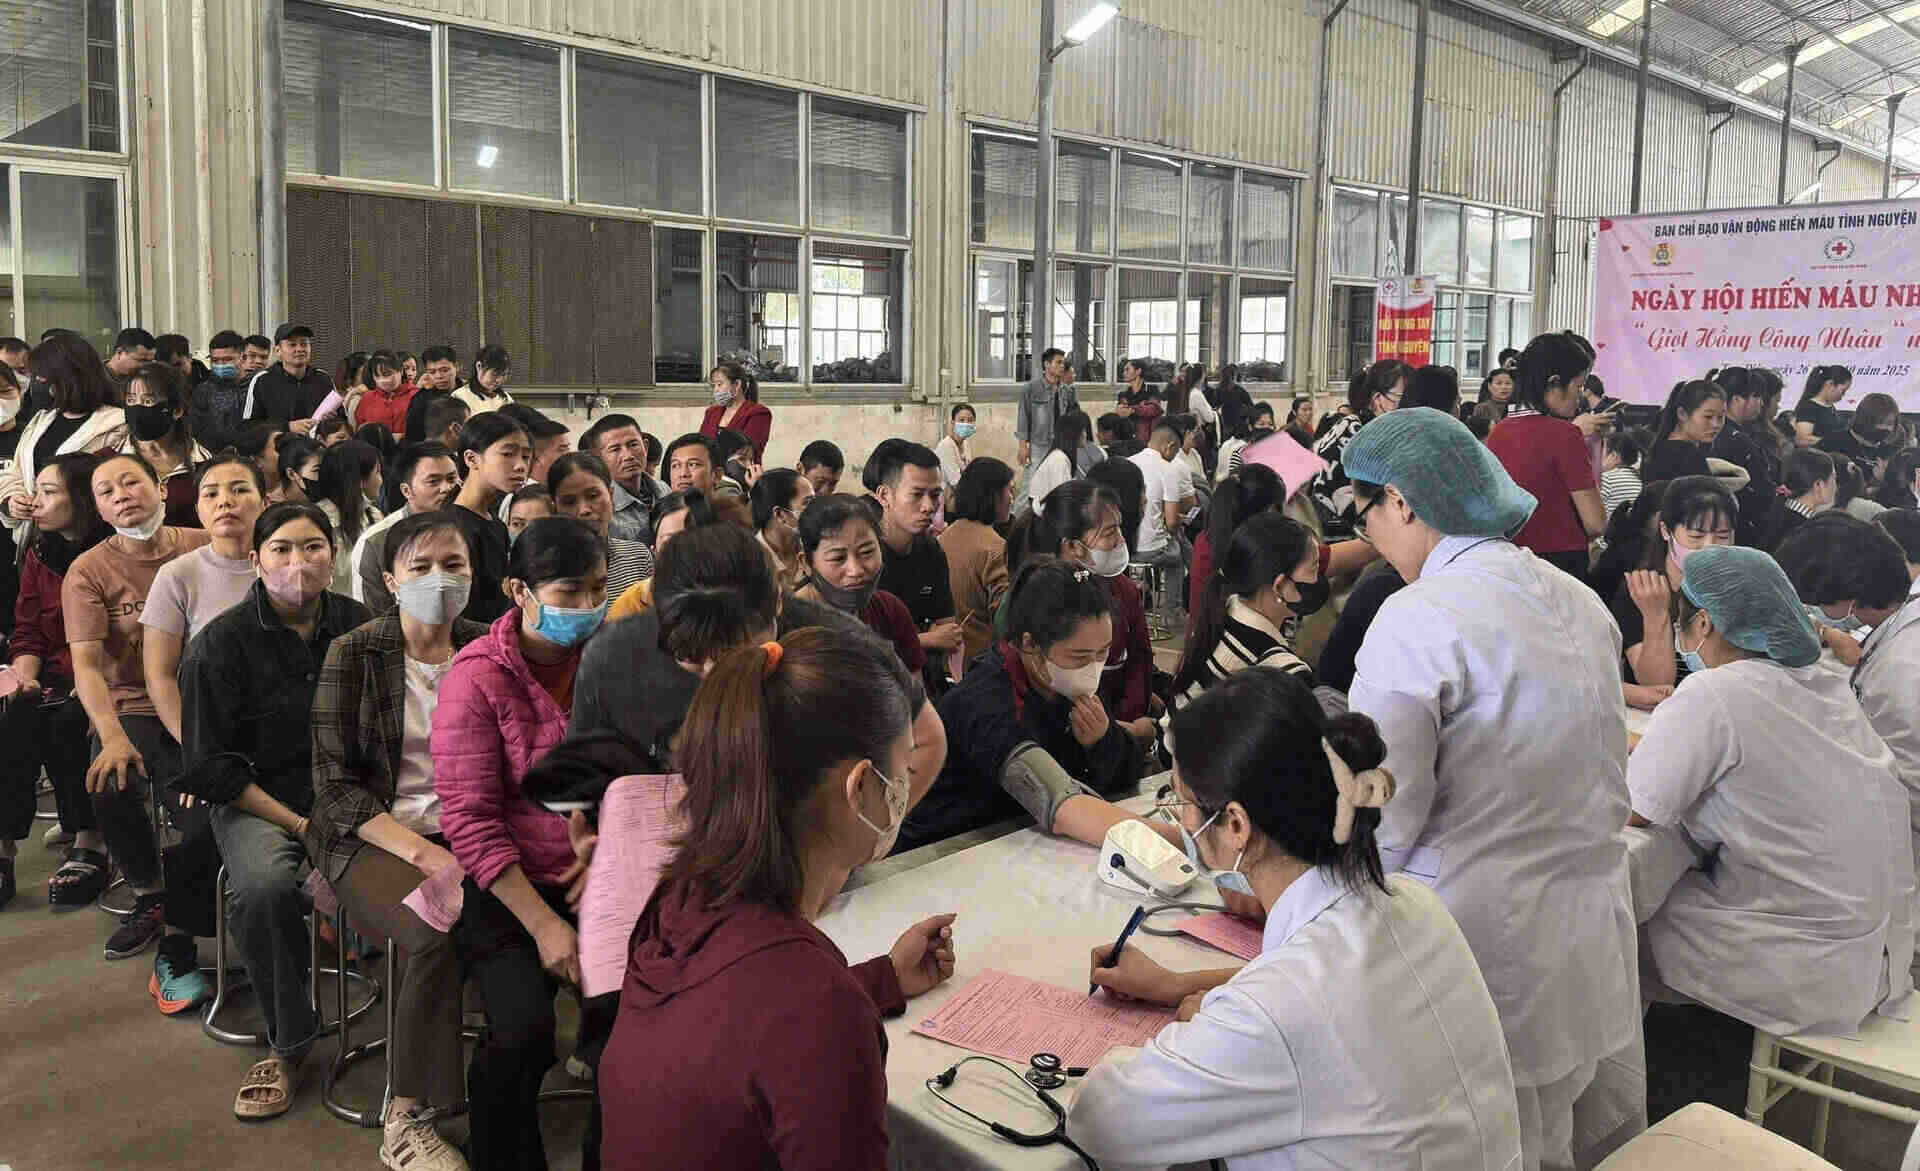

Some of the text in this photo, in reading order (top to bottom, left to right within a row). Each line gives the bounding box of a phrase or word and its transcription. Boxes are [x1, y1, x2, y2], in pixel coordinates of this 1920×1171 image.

[1655, 225, 1676, 237] BAN
[1698, 222, 1719, 238] ĐẠO
[1746, 217, 1777, 236] ĐỘNG
[1779, 214, 1806, 232] HIẾN
[1868, 208, 1918, 229] NGUYỆN
[1631, 282, 1697, 312] NGÀY
[1701, 281, 1745, 315] HỘI
[1750, 276, 1812, 310] HIẾN
[1817, 279, 1879, 309] MÁU
[1759, 326, 1811, 352] Công
